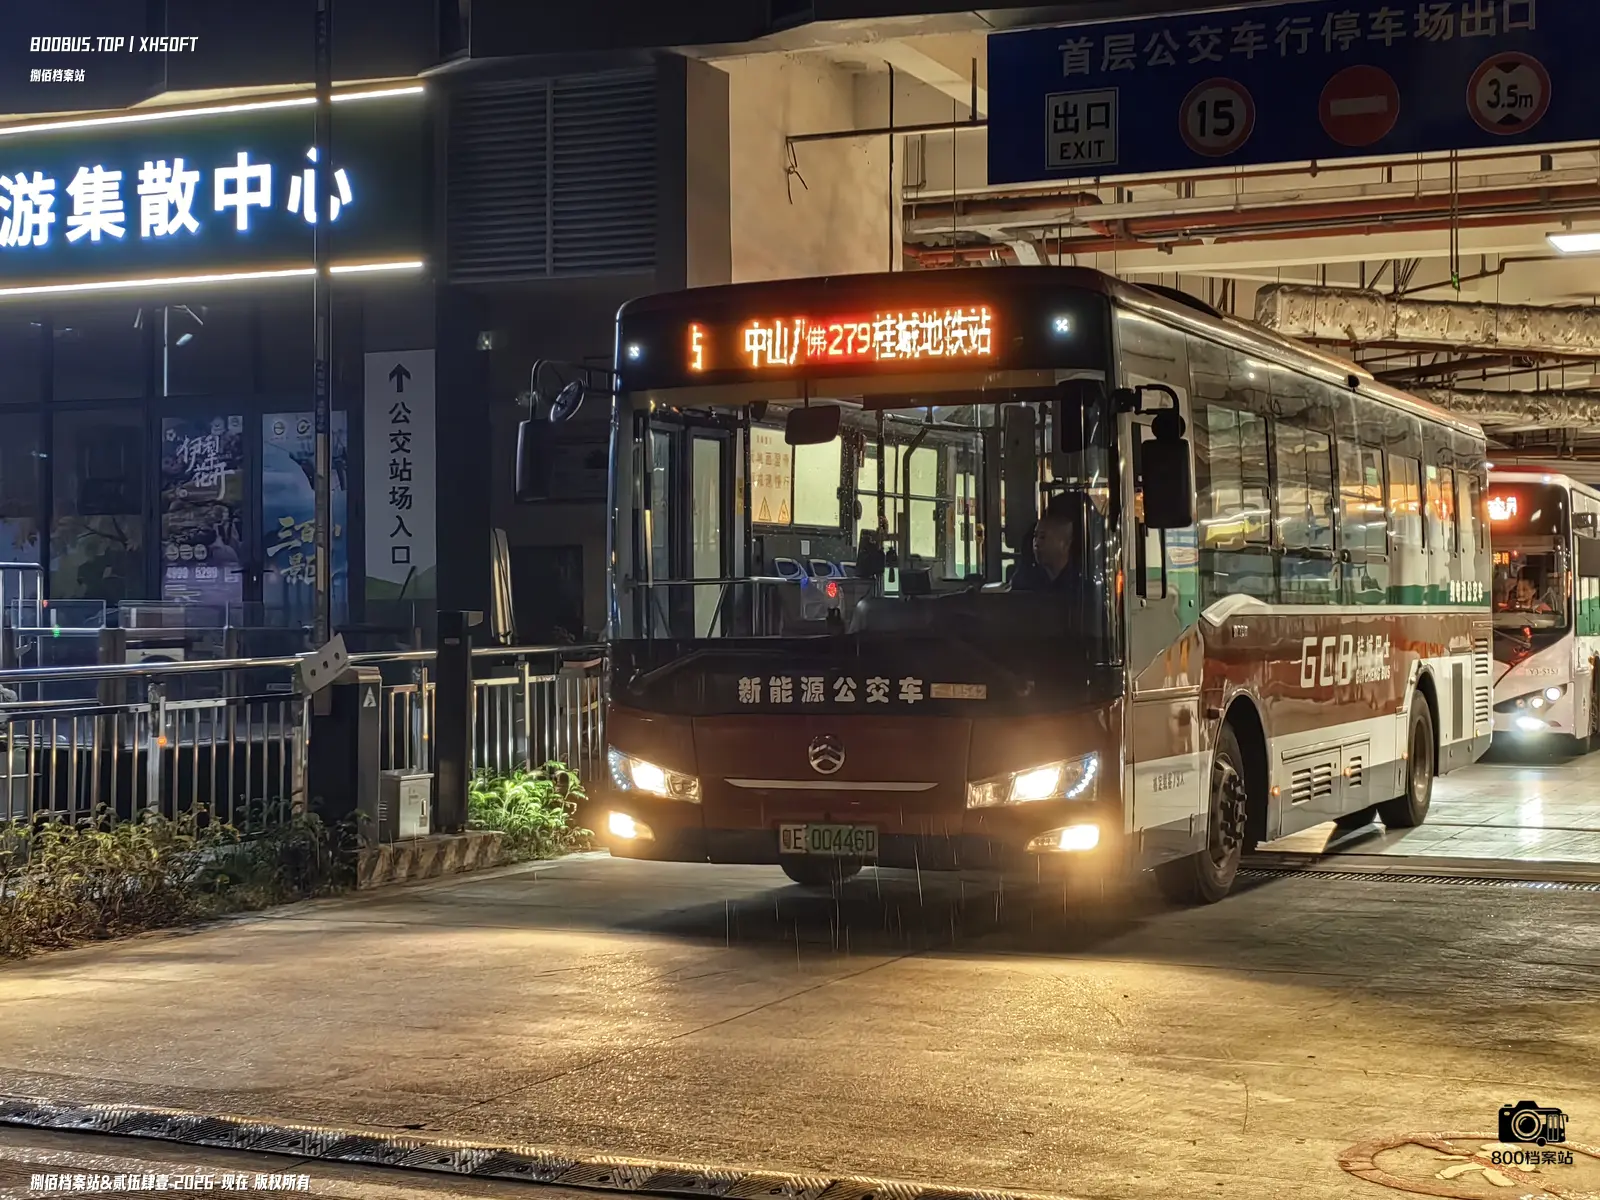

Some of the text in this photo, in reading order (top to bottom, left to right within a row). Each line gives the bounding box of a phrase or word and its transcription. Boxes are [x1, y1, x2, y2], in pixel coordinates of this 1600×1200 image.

[1058, 0, 1537, 77] 首层公交车行停车场出口
[1486, 77, 1534, 111] 3.5m
[1052, 100, 1111, 136] 出口
[1199, 98, 1235, 138] 15
[1059, 138, 1105, 161] EXIT
[0, 146, 353, 248] 游集散中心
[389, 401, 412, 565] 公交站场入口
[1300, 633, 1353, 688] GCB
[737, 676, 924, 704] 新能源公交车
